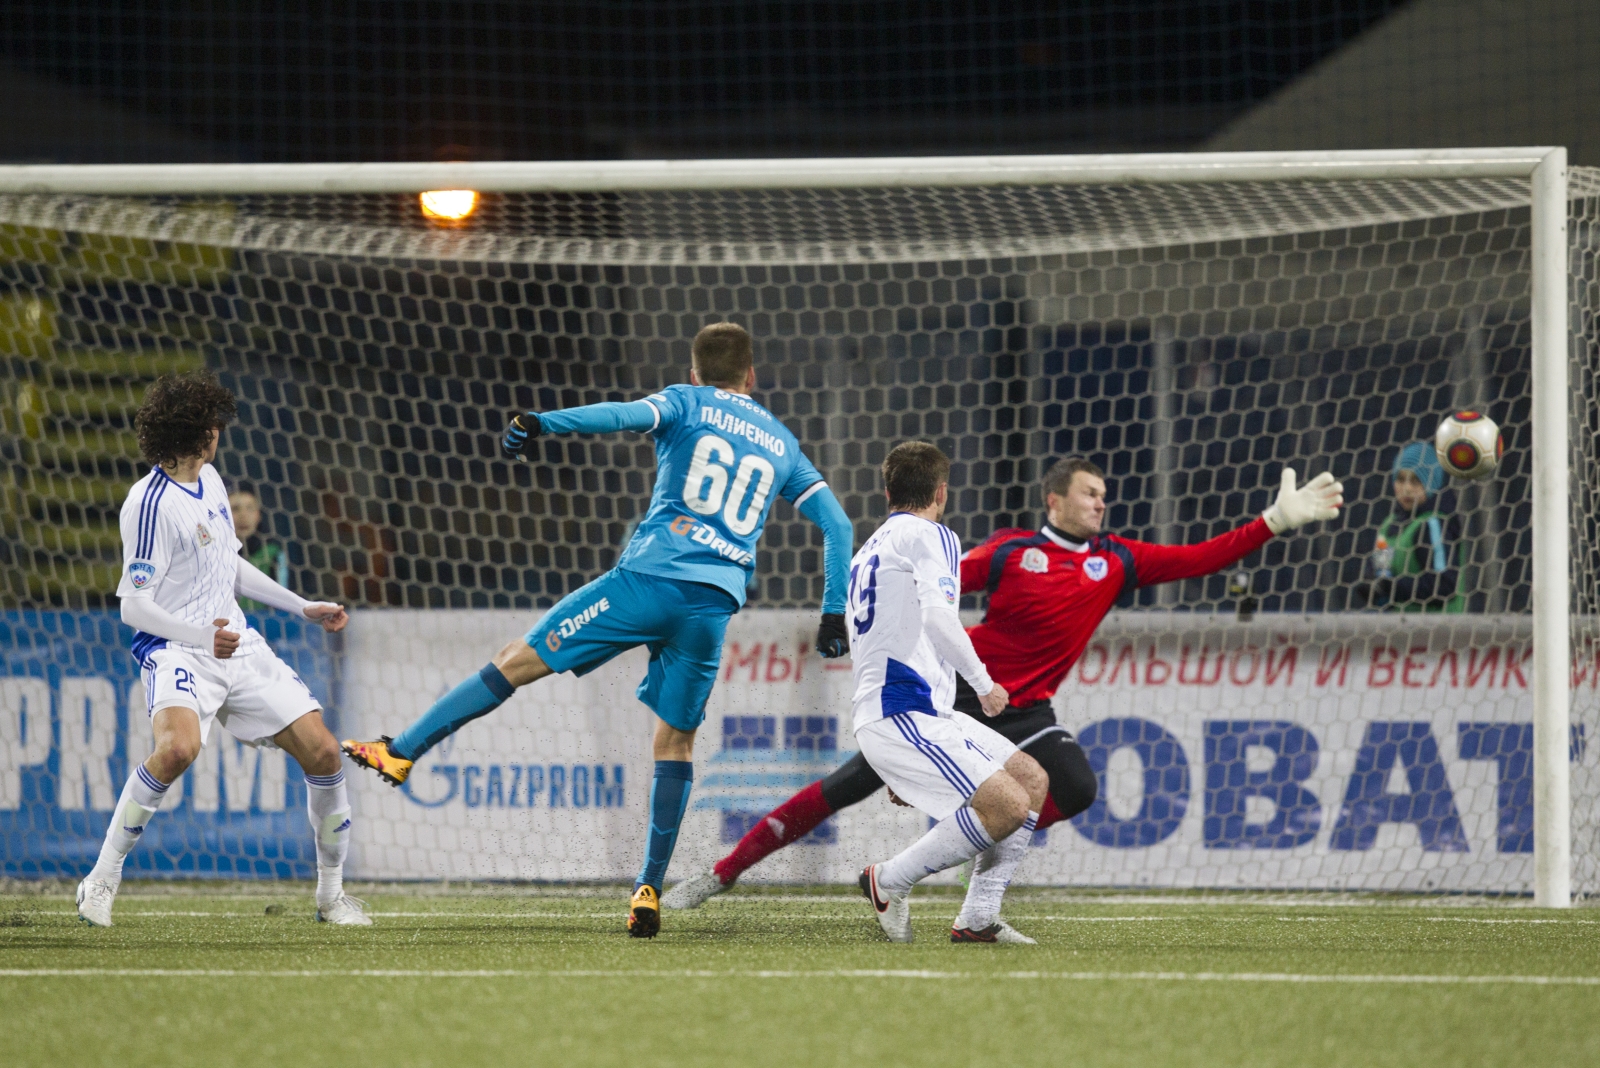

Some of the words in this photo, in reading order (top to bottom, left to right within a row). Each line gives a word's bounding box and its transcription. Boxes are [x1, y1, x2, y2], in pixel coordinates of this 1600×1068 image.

[701, 406, 785, 457] ПАЛИЕНКО
[682, 434, 775, 536] 60
[849, 553, 880, 635] 19
[1066, 633, 1299, 687] ОЛЬШОЙ
[1315, 643, 1350, 687] И
[1367, 632, 1600, 690] ВЕЛИКЙ
[464, 763, 624, 809] GAZPROM
[928, 717, 1585, 853] ОВАТ
